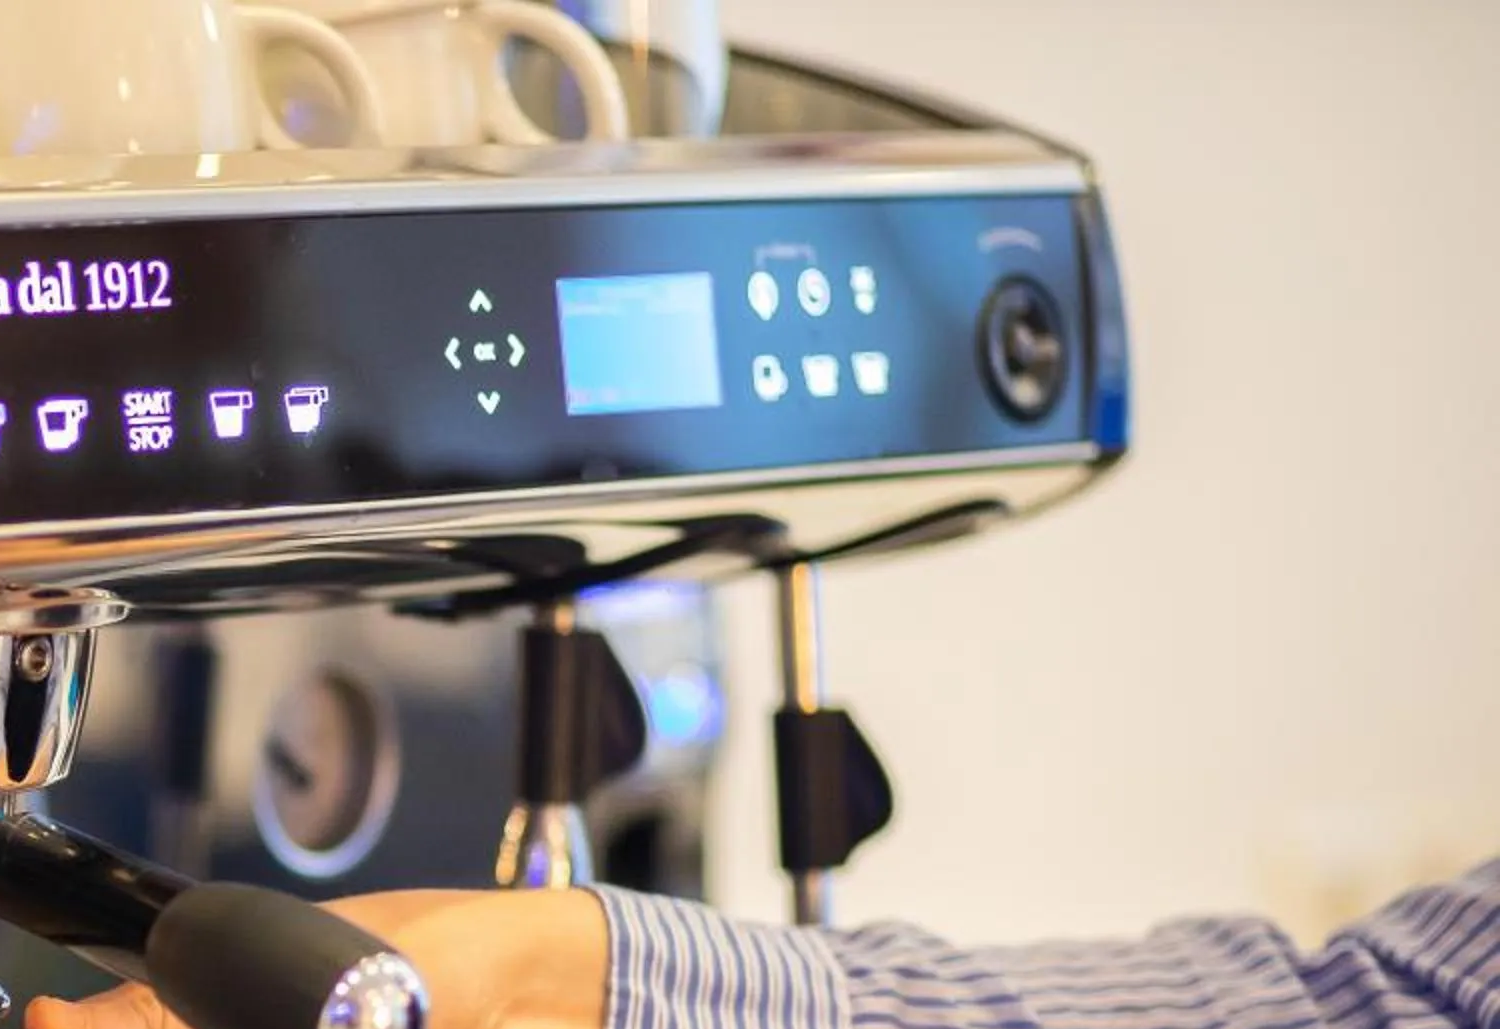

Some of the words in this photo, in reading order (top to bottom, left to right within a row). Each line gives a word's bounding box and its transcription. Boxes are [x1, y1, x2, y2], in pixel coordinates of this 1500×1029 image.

[18, 261, 76, 314] dal
[84, 260, 172, 311] 1912
[123, 391, 173, 416] START
[128, 425, 173, 452] STOP
